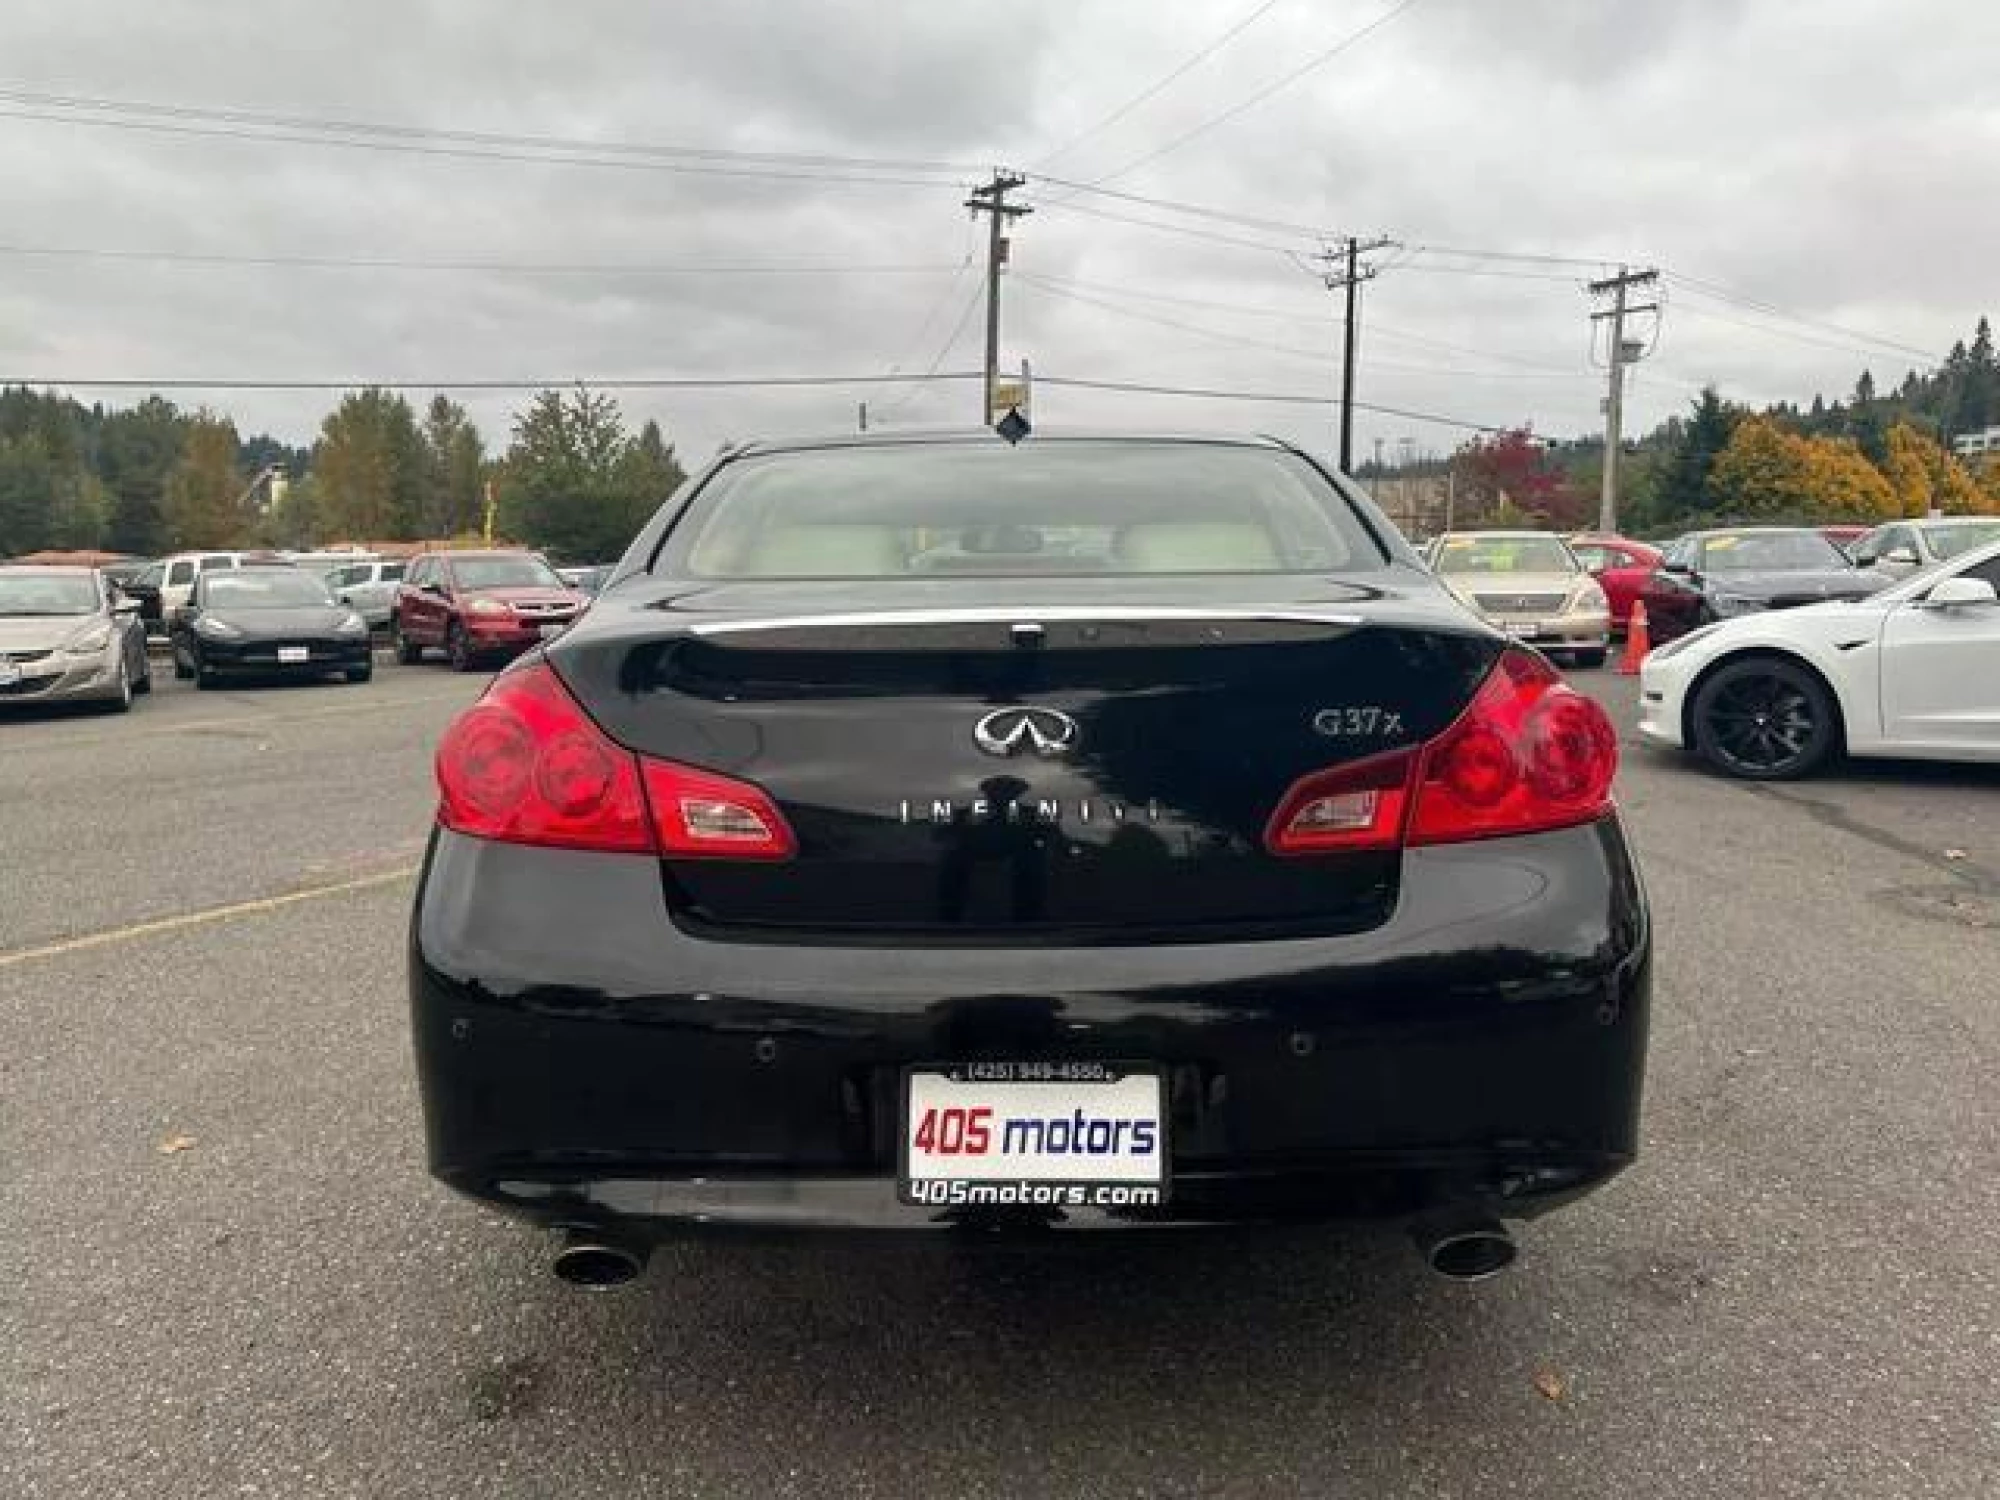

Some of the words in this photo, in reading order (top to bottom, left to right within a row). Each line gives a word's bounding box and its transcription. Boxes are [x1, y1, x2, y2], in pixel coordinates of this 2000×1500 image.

[1313, 706, 1404, 735] G37x
[914, 1108, 993, 1154] 405
[1002, 1108, 1157, 1154] motors
[911, 1181, 1159, 1204] 405motors.com
